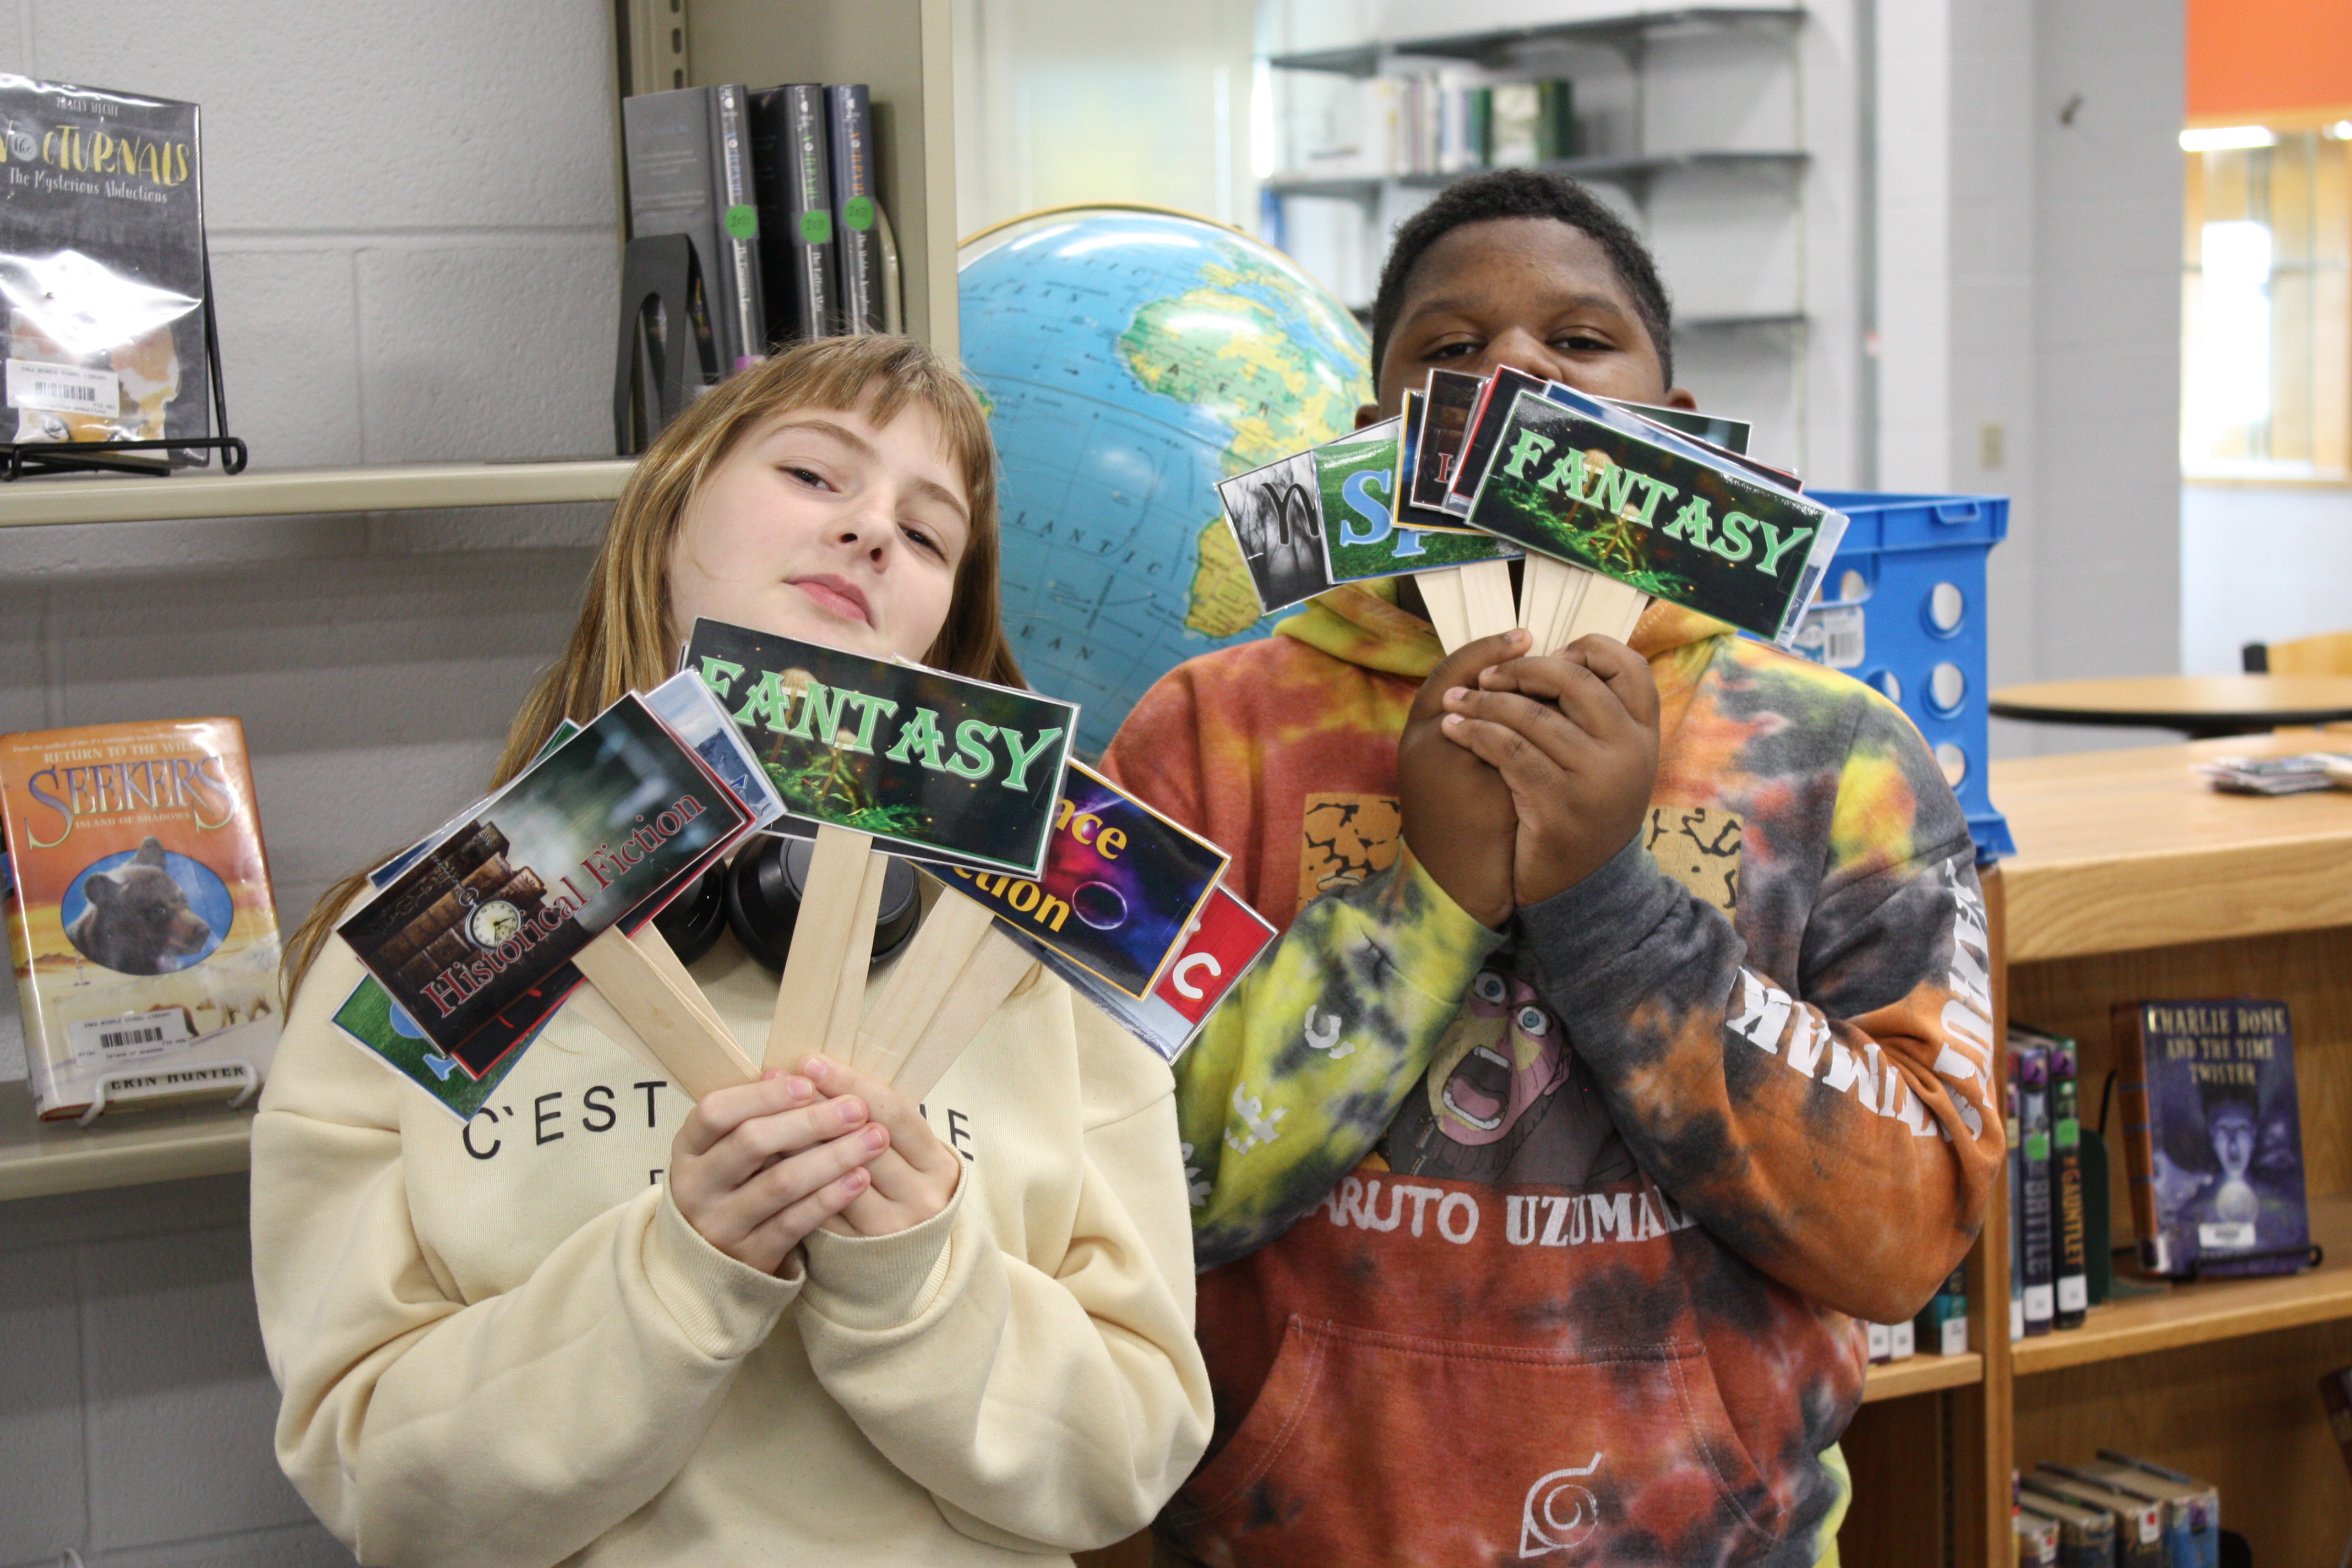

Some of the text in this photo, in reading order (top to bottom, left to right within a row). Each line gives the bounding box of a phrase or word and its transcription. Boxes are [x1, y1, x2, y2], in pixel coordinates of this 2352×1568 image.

[9, 167, 168, 204] The Mysterious Abductions
[1504, 427, 1815, 578] FANTASY
[43, 746, 103, 765] RETURN
[108, 744, 127, 758] TO
[131, 742, 160, 756] THE
[700, 655, 1063, 792] FANTASY
[25, 756, 240, 851] SEEKERS
[75, 812, 192, 830] ISLAND OF SHADOWS
[420, 875, 589, 1018] Historical
[580, 794, 706, 890] Fiction
[2148, 1006, 2286, 1036] CHARLIE BONE
